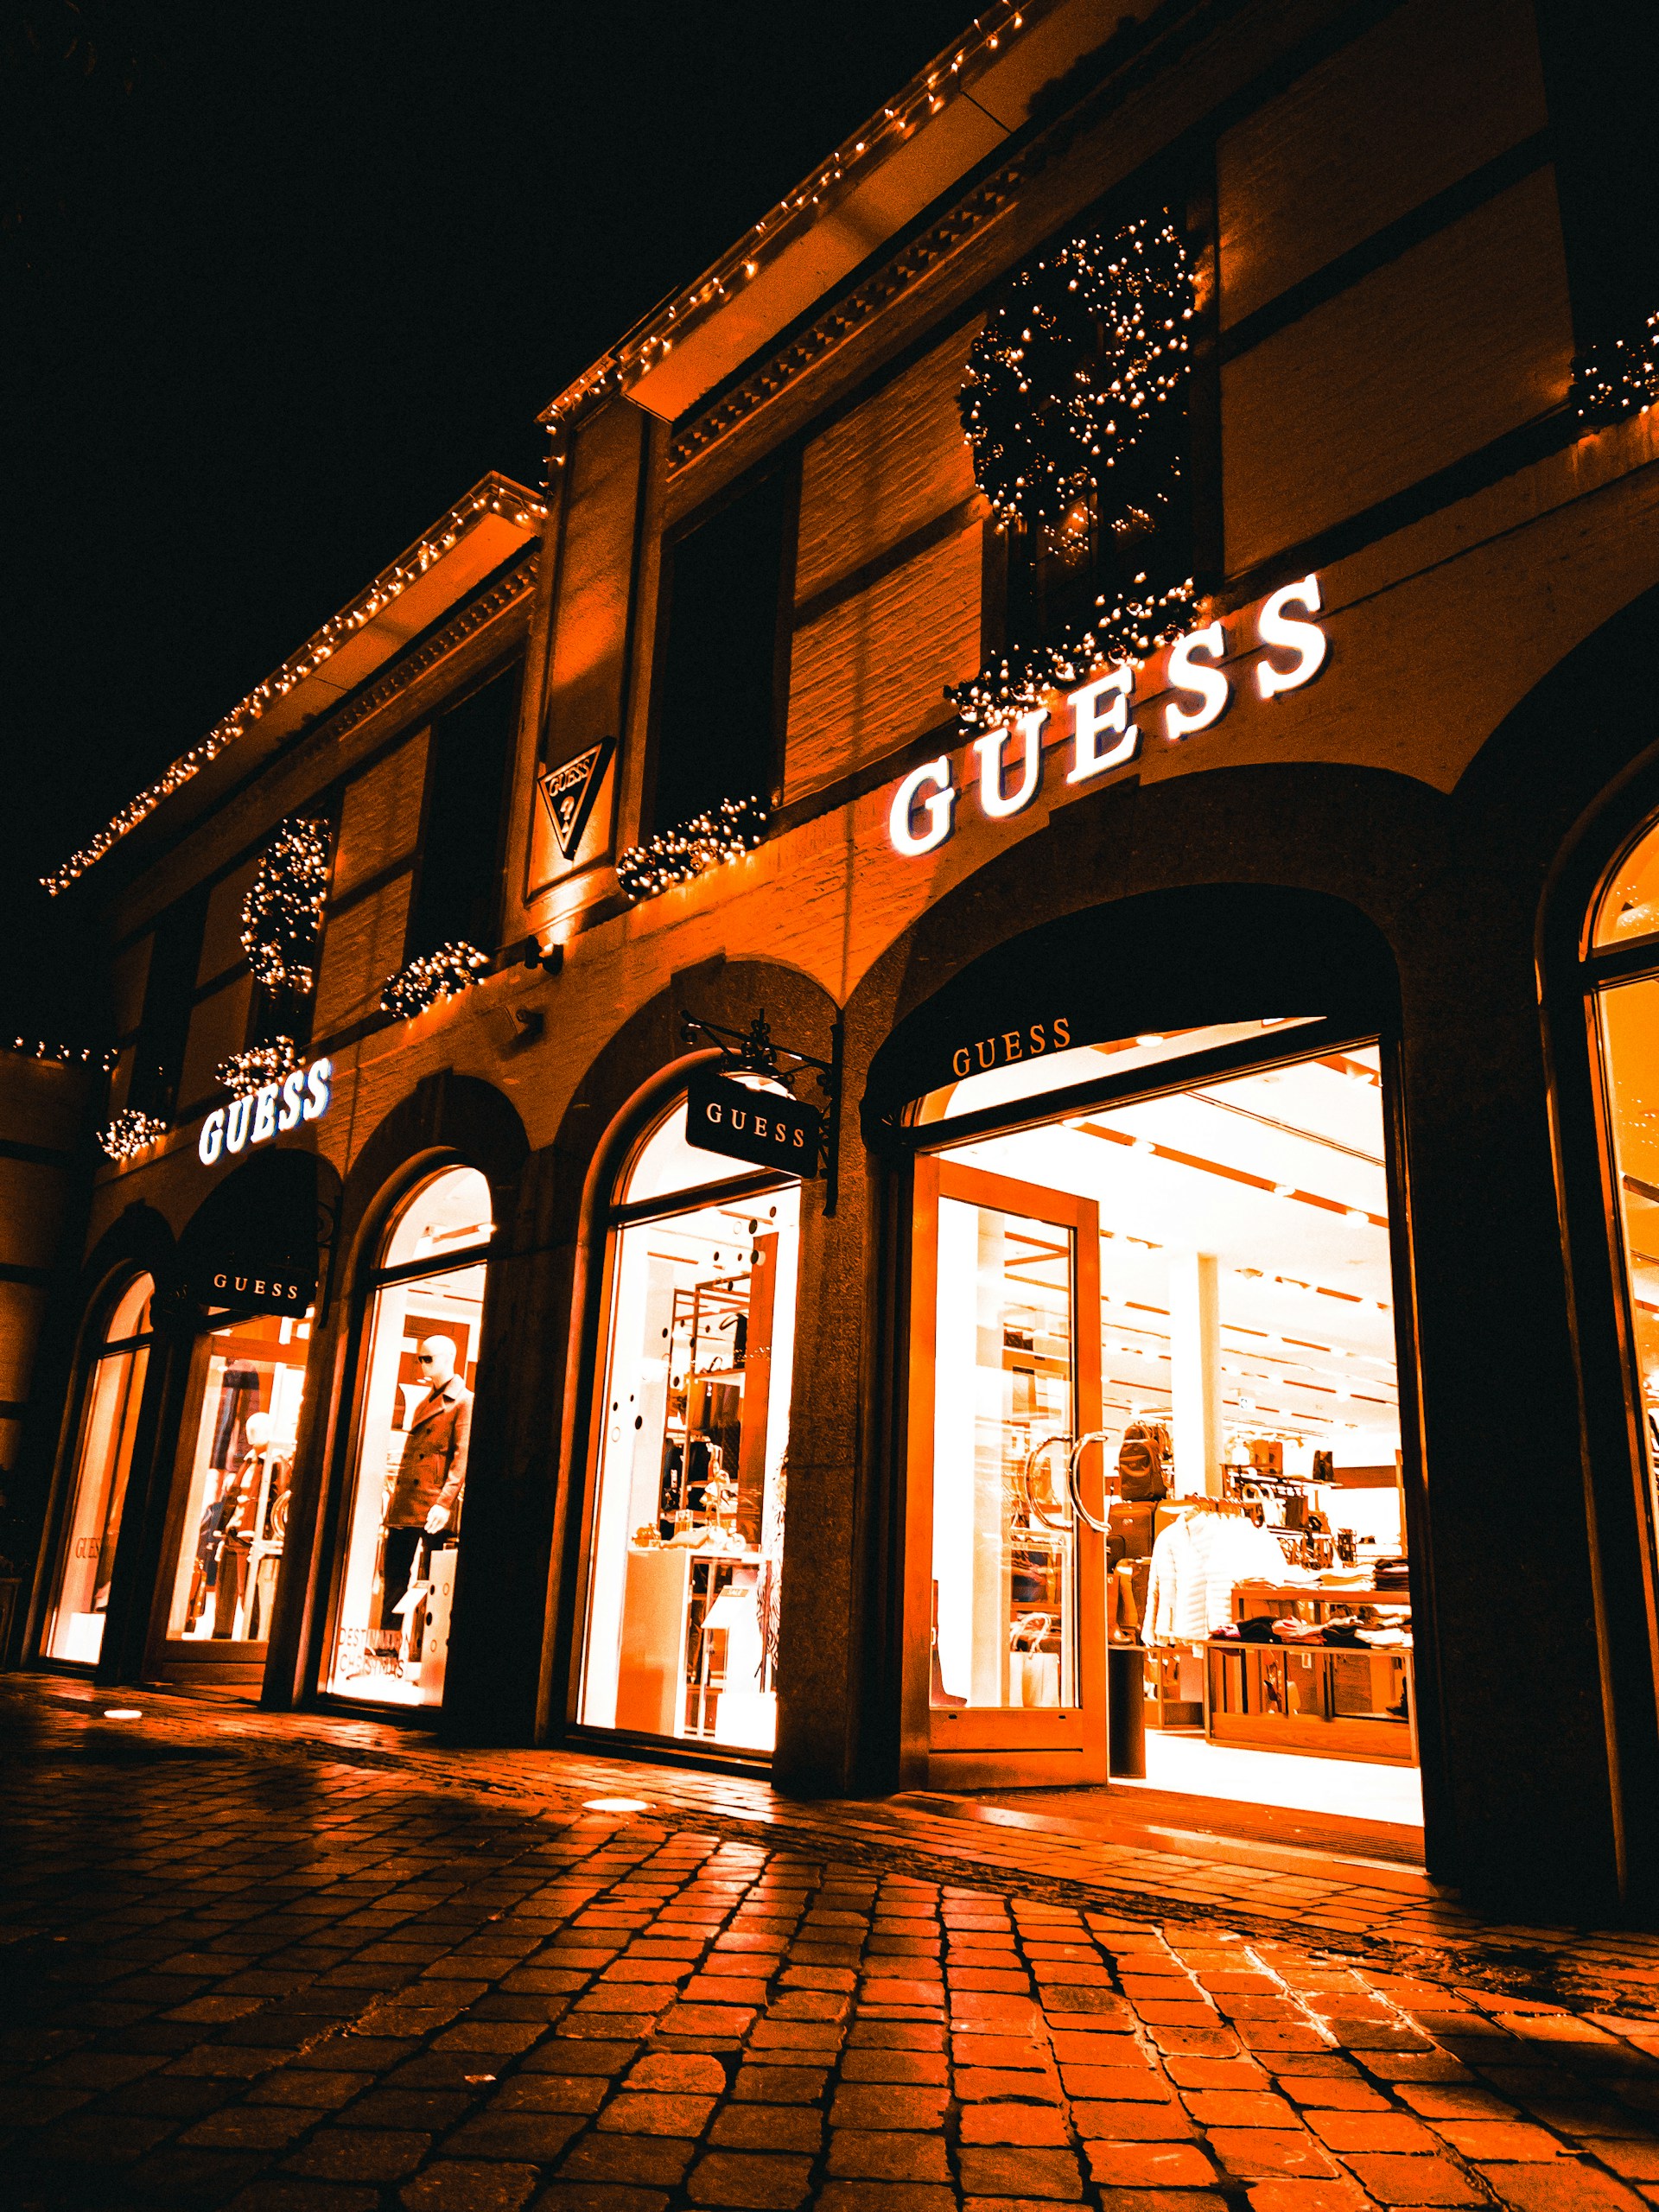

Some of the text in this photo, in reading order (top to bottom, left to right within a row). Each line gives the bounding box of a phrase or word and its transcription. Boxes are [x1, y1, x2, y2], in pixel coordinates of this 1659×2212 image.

[888, 573, 1327, 856] GUESS
[549, 758, 590, 797] GUESS
[952, 1017, 1071, 1077] GUESS
[198, 1057, 331, 1166] GUESS
[706, 1103, 804, 1147] GUESS
[213, 1274, 298, 1300] GUESS
